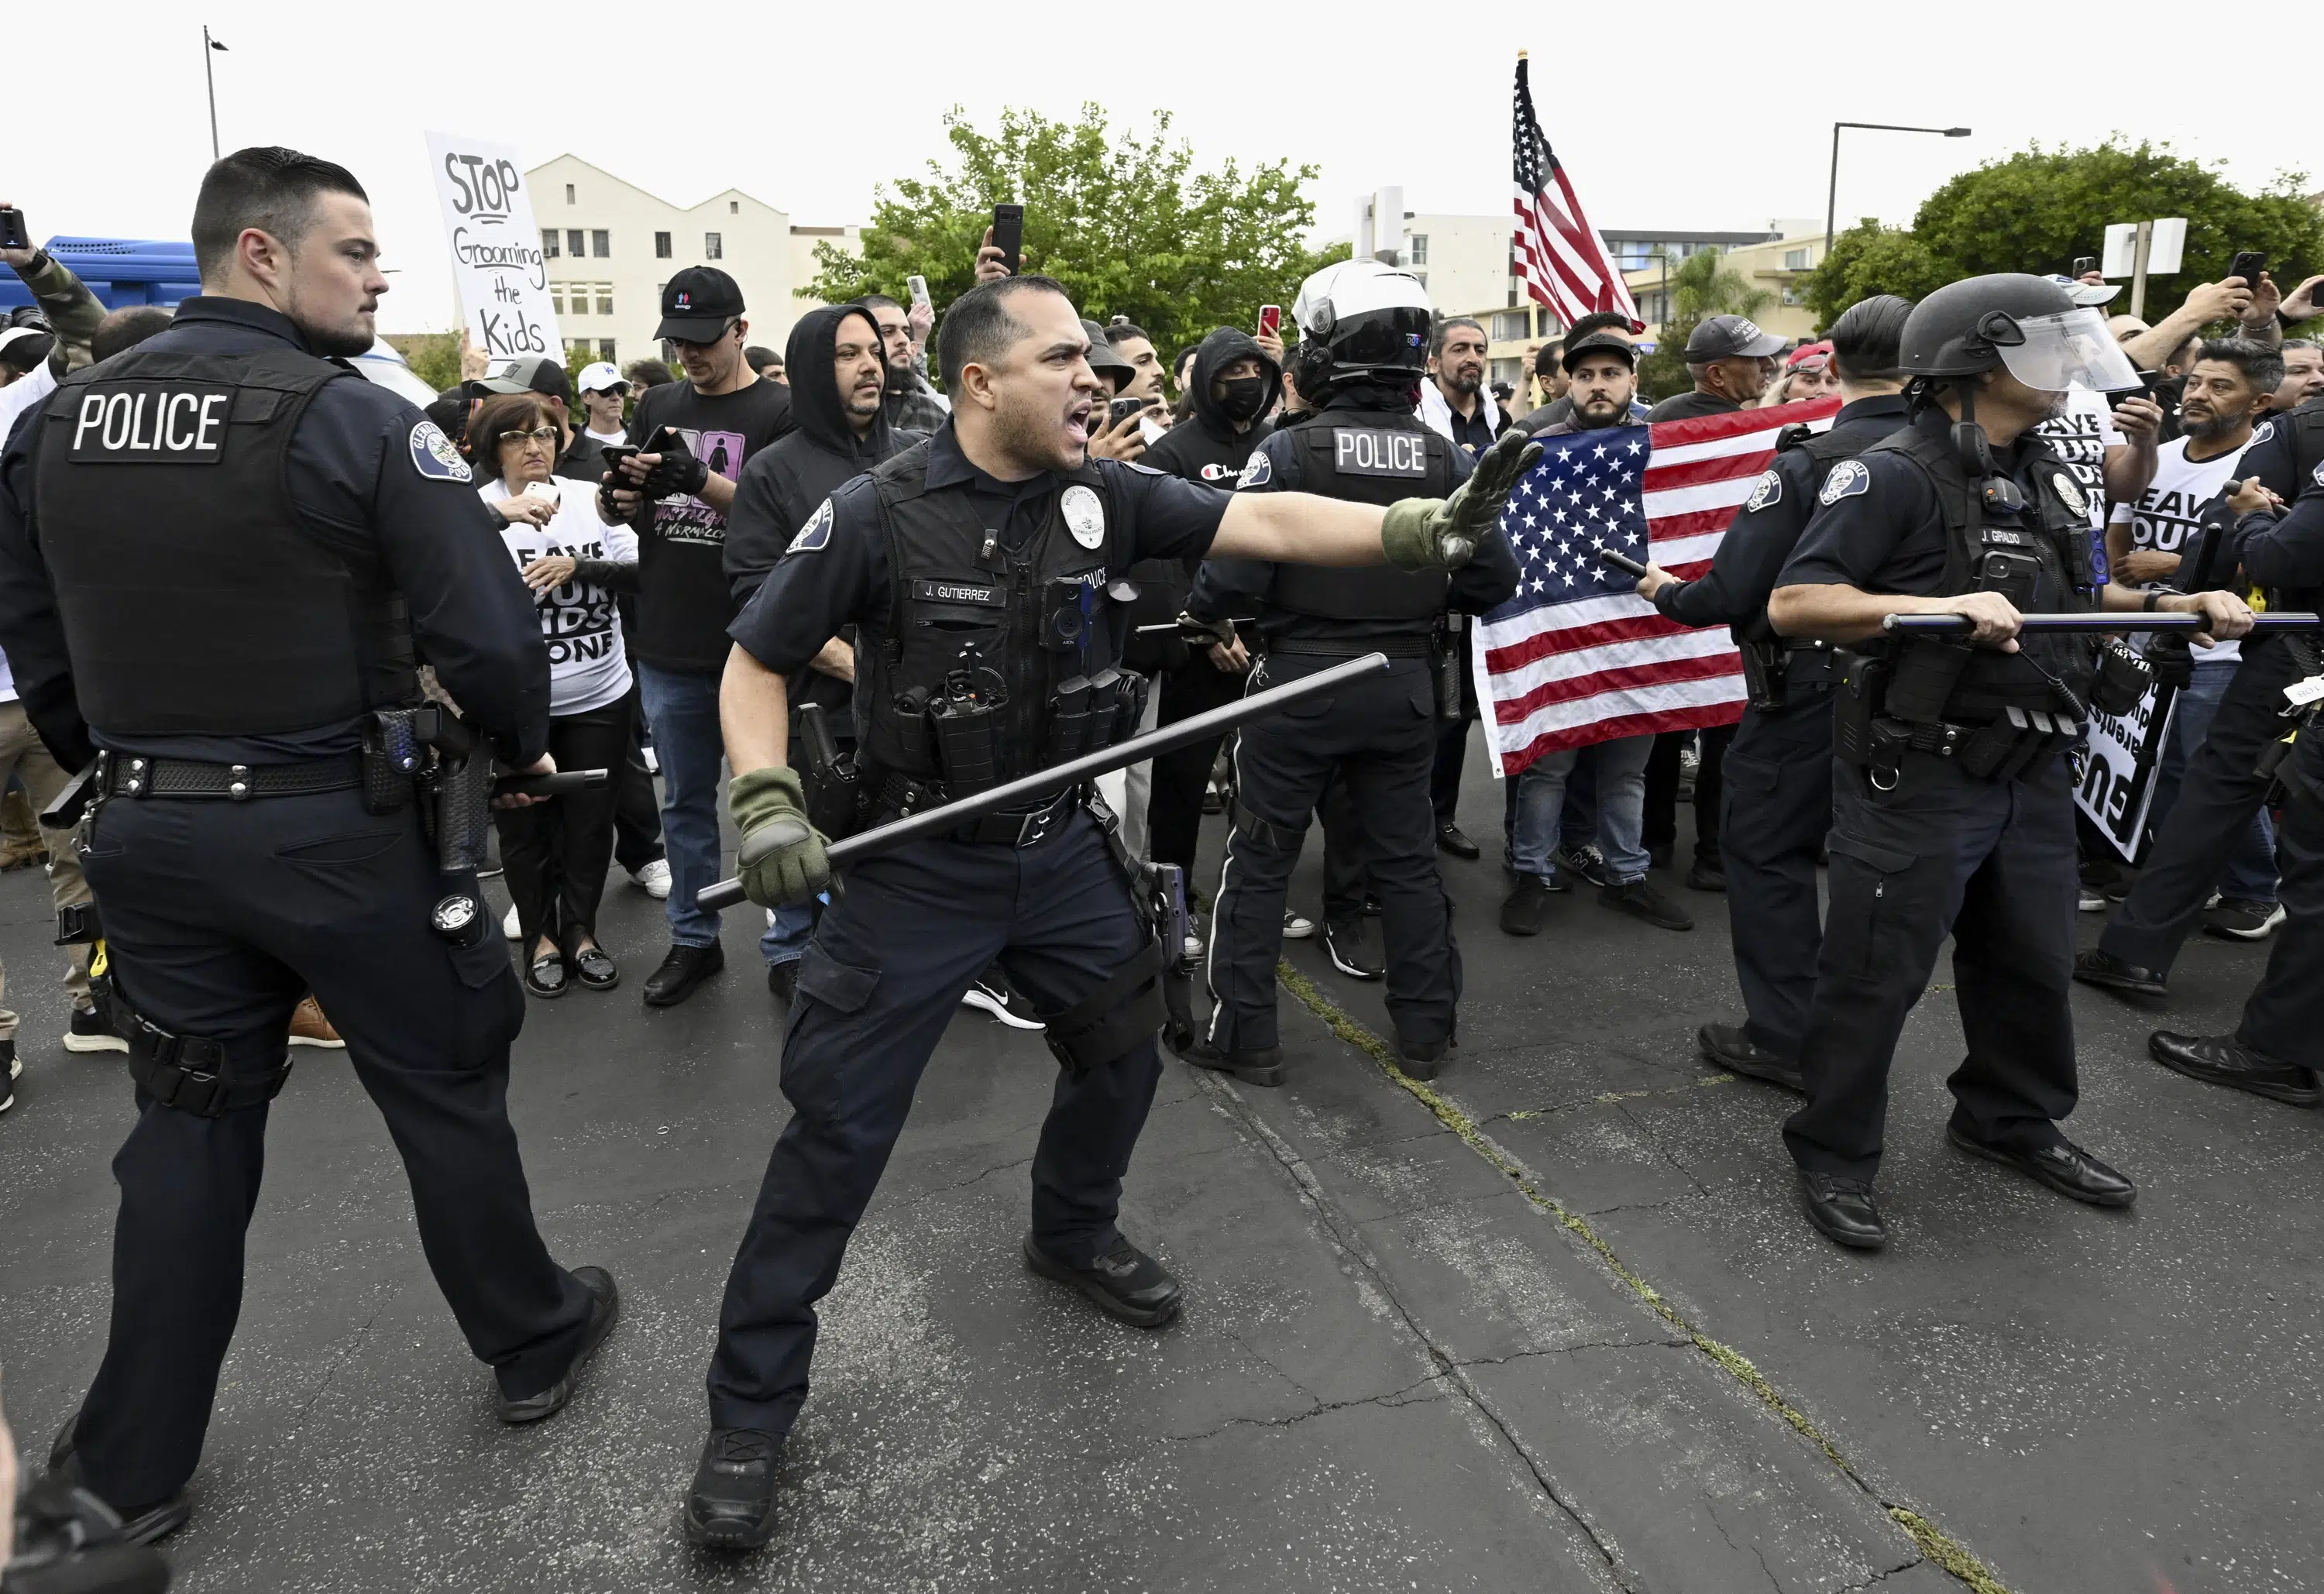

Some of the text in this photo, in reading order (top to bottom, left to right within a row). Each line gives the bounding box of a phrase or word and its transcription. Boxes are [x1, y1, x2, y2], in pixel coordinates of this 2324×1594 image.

[445, 153, 519, 214] STOP
[454, 227, 545, 290] Grooming
[494, 276, 522, 304] the
[480, 309, 545, 355] Kids
[73, 393, 227, 451] POLICE
[2042, 414, 2100, 435] AVE
[1338, 433, 1424, 470] POLICE
[2050, 438, 2105, 464] UR
[1831, 461, 1866, 477] GLENDALE
[1066, 490, 1097, 506] POLICE OFFICER
[2132, 487, 2209, 520] EAV
[1982, 530, 2020, 544] J. GIRALDO
[2132, 516, 2199, 551] OU
[517, 541, 604, 569] EAVE
[1078, 566, 1106, 589] OLICE
[535, 580, 609, 606] UR
[926, 586, 991, 602] J. GUTIERREZ
[538, 603, 610, 634] IDS
[546, 632, 613, 665] ONE
[2090, 705, 2141, 761] arents
